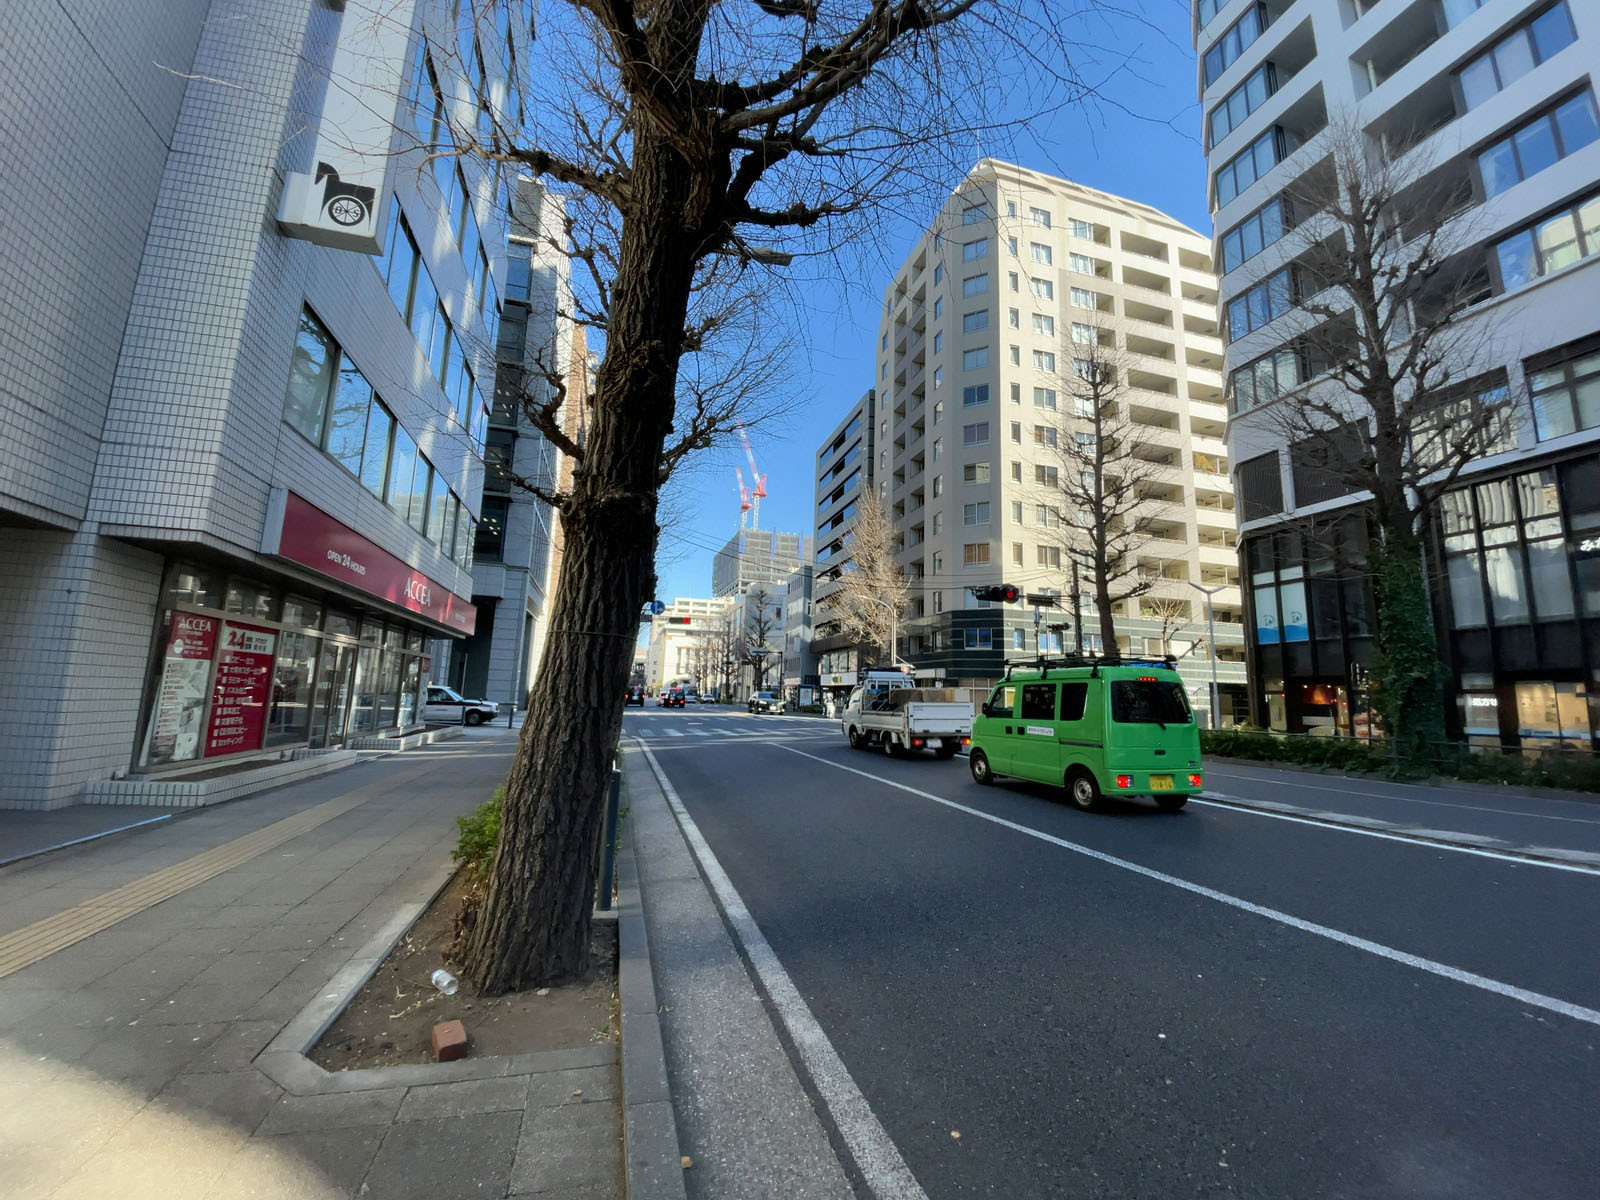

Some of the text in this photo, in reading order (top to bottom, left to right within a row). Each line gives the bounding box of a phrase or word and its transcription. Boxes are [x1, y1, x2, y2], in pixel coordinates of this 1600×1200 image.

[328, 550, 366, 576] OPEN 24 HOURS
[404, 578, 431, 606] ACCEA
[178, 617, 211, 633] ACCEA
